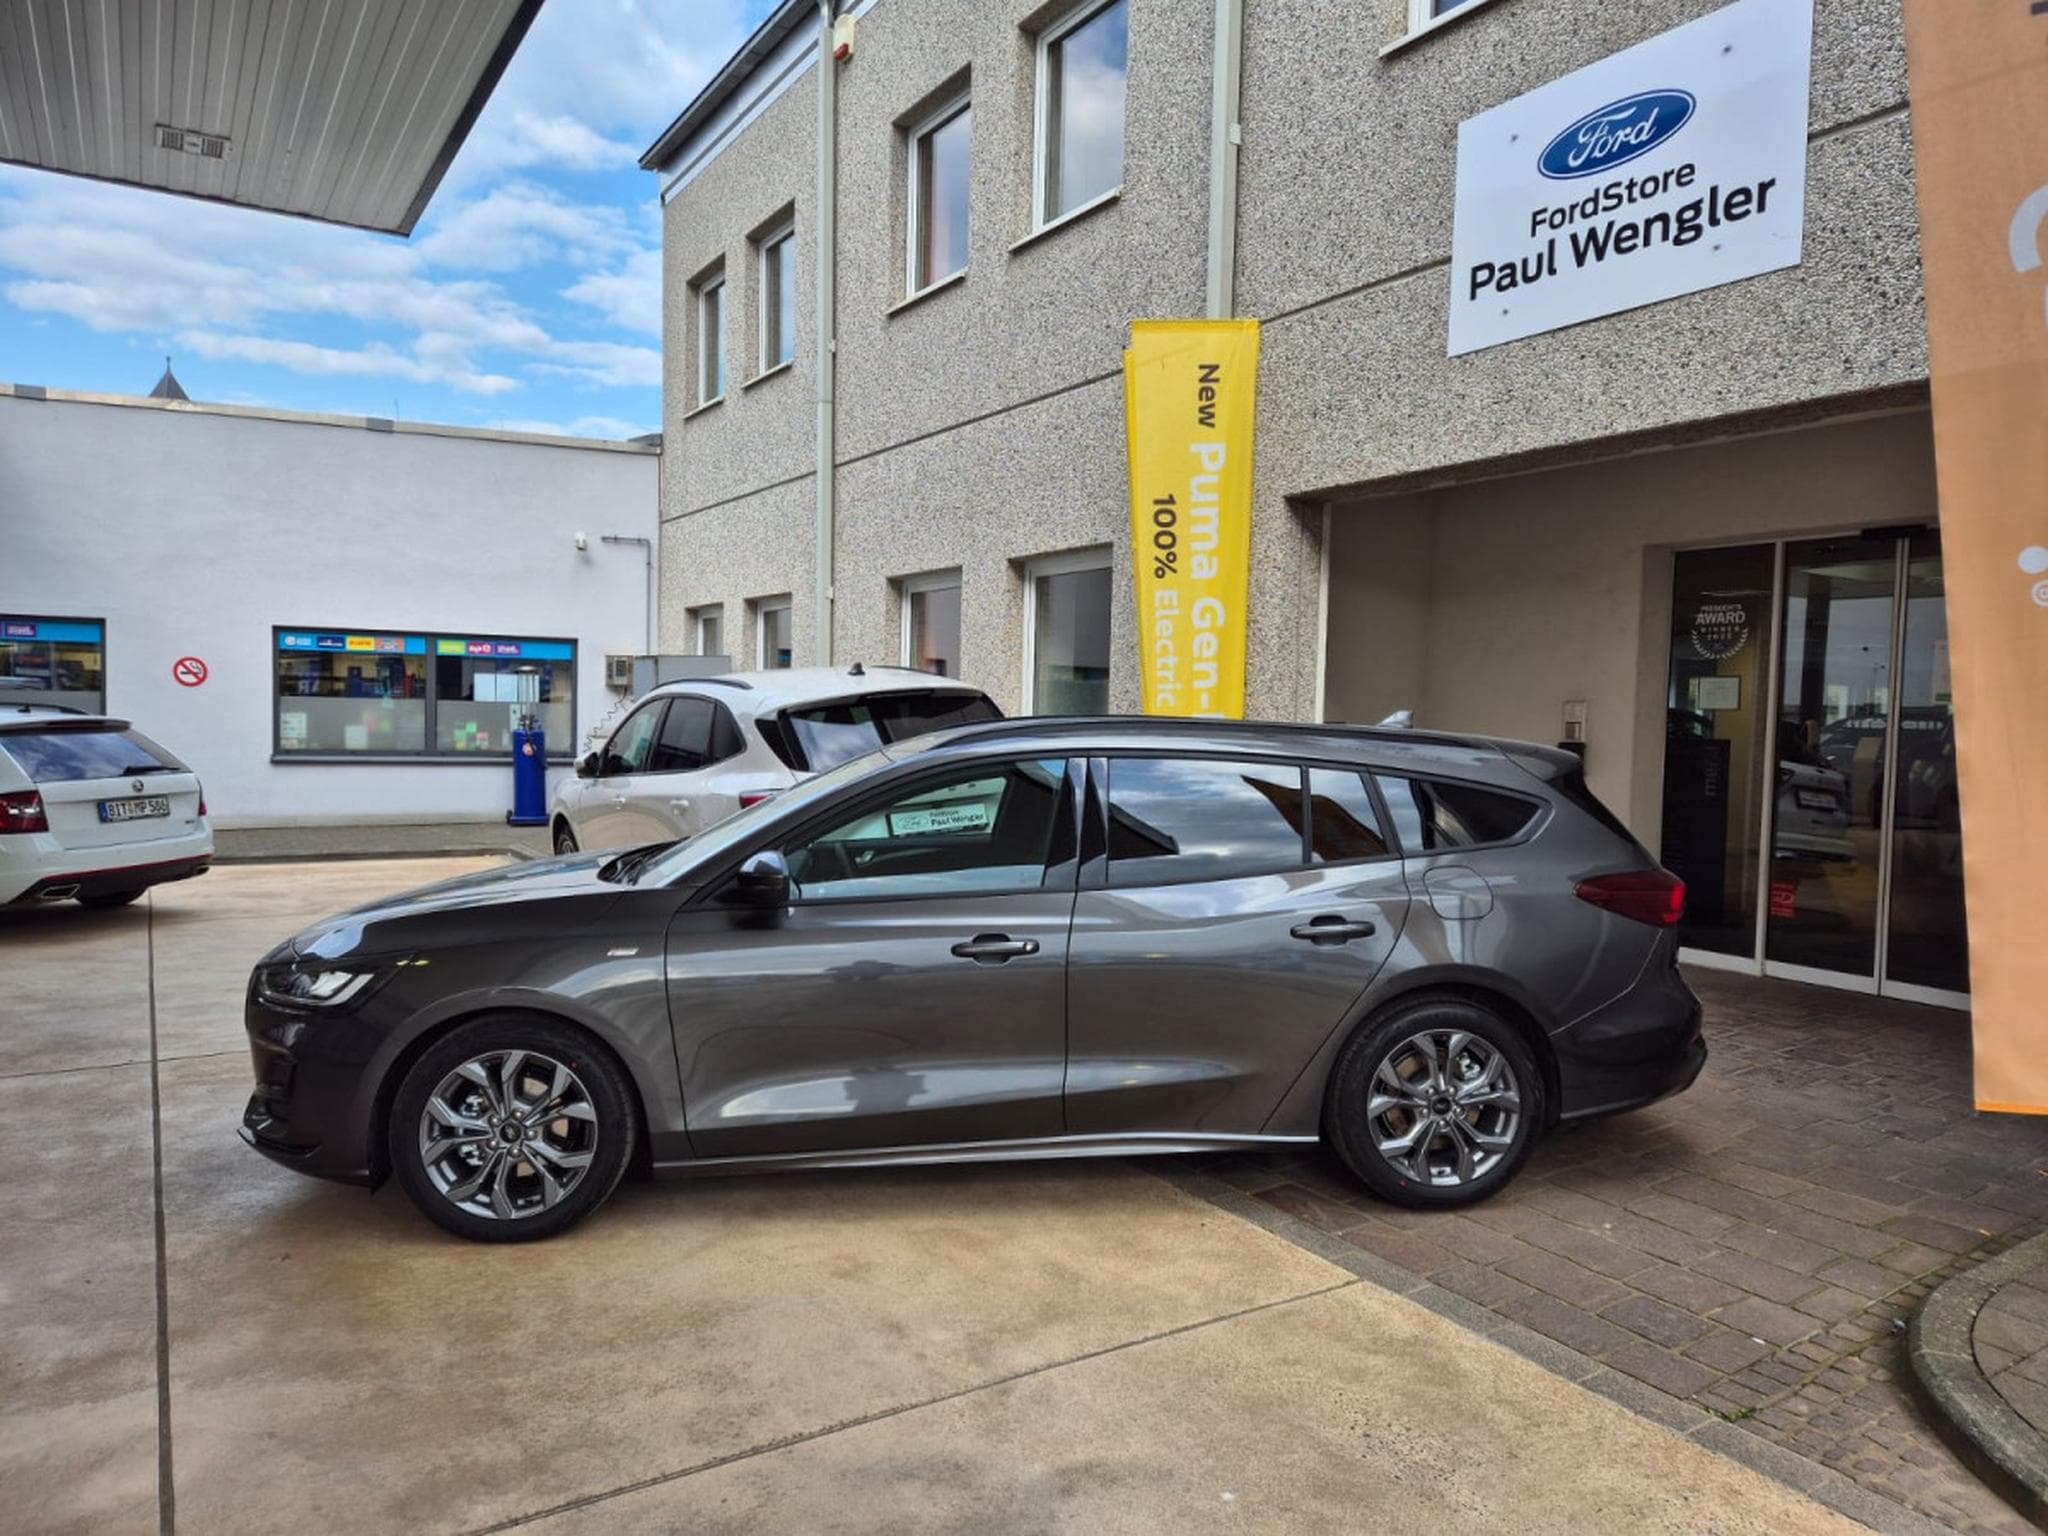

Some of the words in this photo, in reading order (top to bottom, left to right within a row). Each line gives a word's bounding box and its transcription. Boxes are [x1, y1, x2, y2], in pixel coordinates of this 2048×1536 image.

[1567, 105, 1660, 169] Ford
[1469, 238, 1558, 301] Paul
[1569, 177, 1777, 269] Wengler
[1530, 162, 1696, 238] FordStore
[1197, 363, 1220, 430] New
[1152, 493, 1178, 580] 100%
[1189, 441, 1227, 581] Puma
[1154, 589, 1182, 708] Electric
[1190, 596, 1226, 719] Gen-
[1695, 611, 1746, 625] AWARD
[108, 802, 127, 817] BIT
